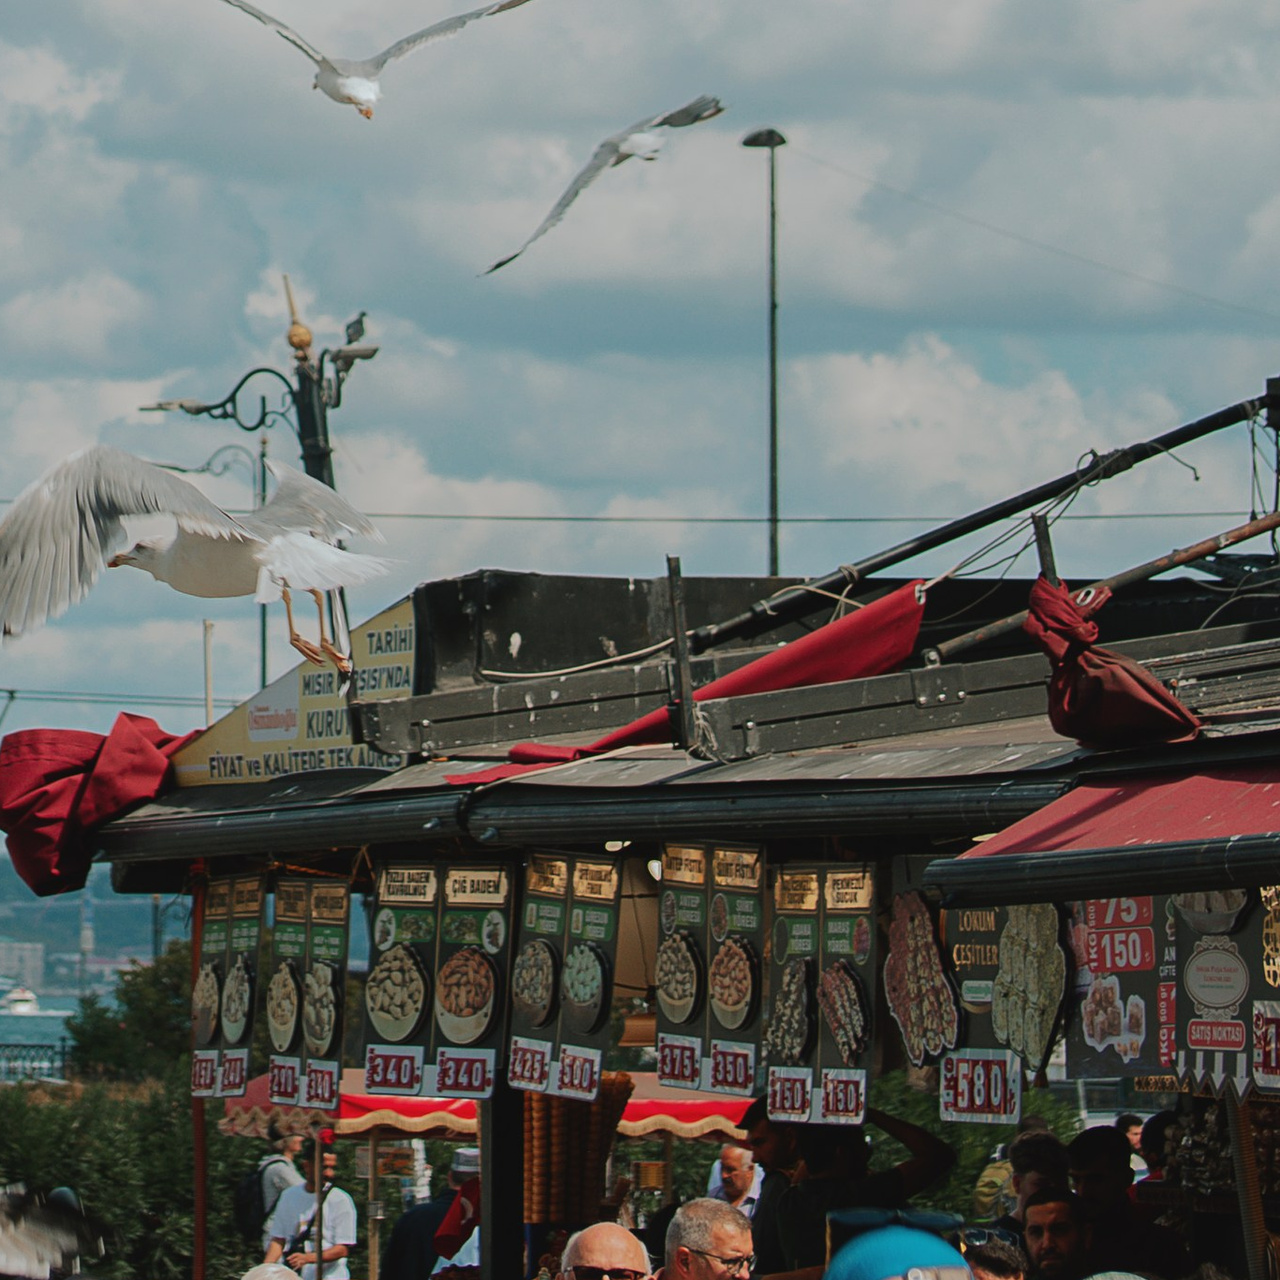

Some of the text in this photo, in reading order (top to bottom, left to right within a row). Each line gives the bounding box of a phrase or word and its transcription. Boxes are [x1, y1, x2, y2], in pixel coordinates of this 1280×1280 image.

[367, 623, 413, 656] TARİHİ
[302, 671, 334, 697] MISIR
[208, 750, 243, 779] FİYAT
[246, 758, 261, 777] ve
[263, 746, 325, 776] KALİTEDE
[328, 747, 354, 768] TEK
[452, 875, 501, 898] ÇİĞ BADEM
[835, 891, 859, 904] SUCUK
[959, 911, 996, 932] LOKUM
[1101, 931, 1141, 968] 150
[1191, 1025, 1243, 1045] SATIŞ NOKTASI
[373, 1057, 412, 1084] 340
[444, 1060, 483, 1087] 340
[513, 1049, 542, 1080] 425
[563, 1055, 590, 1089] 500
[662, 1046, 692, 1080] 375
[716, 1053, 745, 1083] 350
[775, 1080, 802, 1109] 150
[828, 1083, 856, 1111] 150
[958, 1062, 1002, 1109] 580
